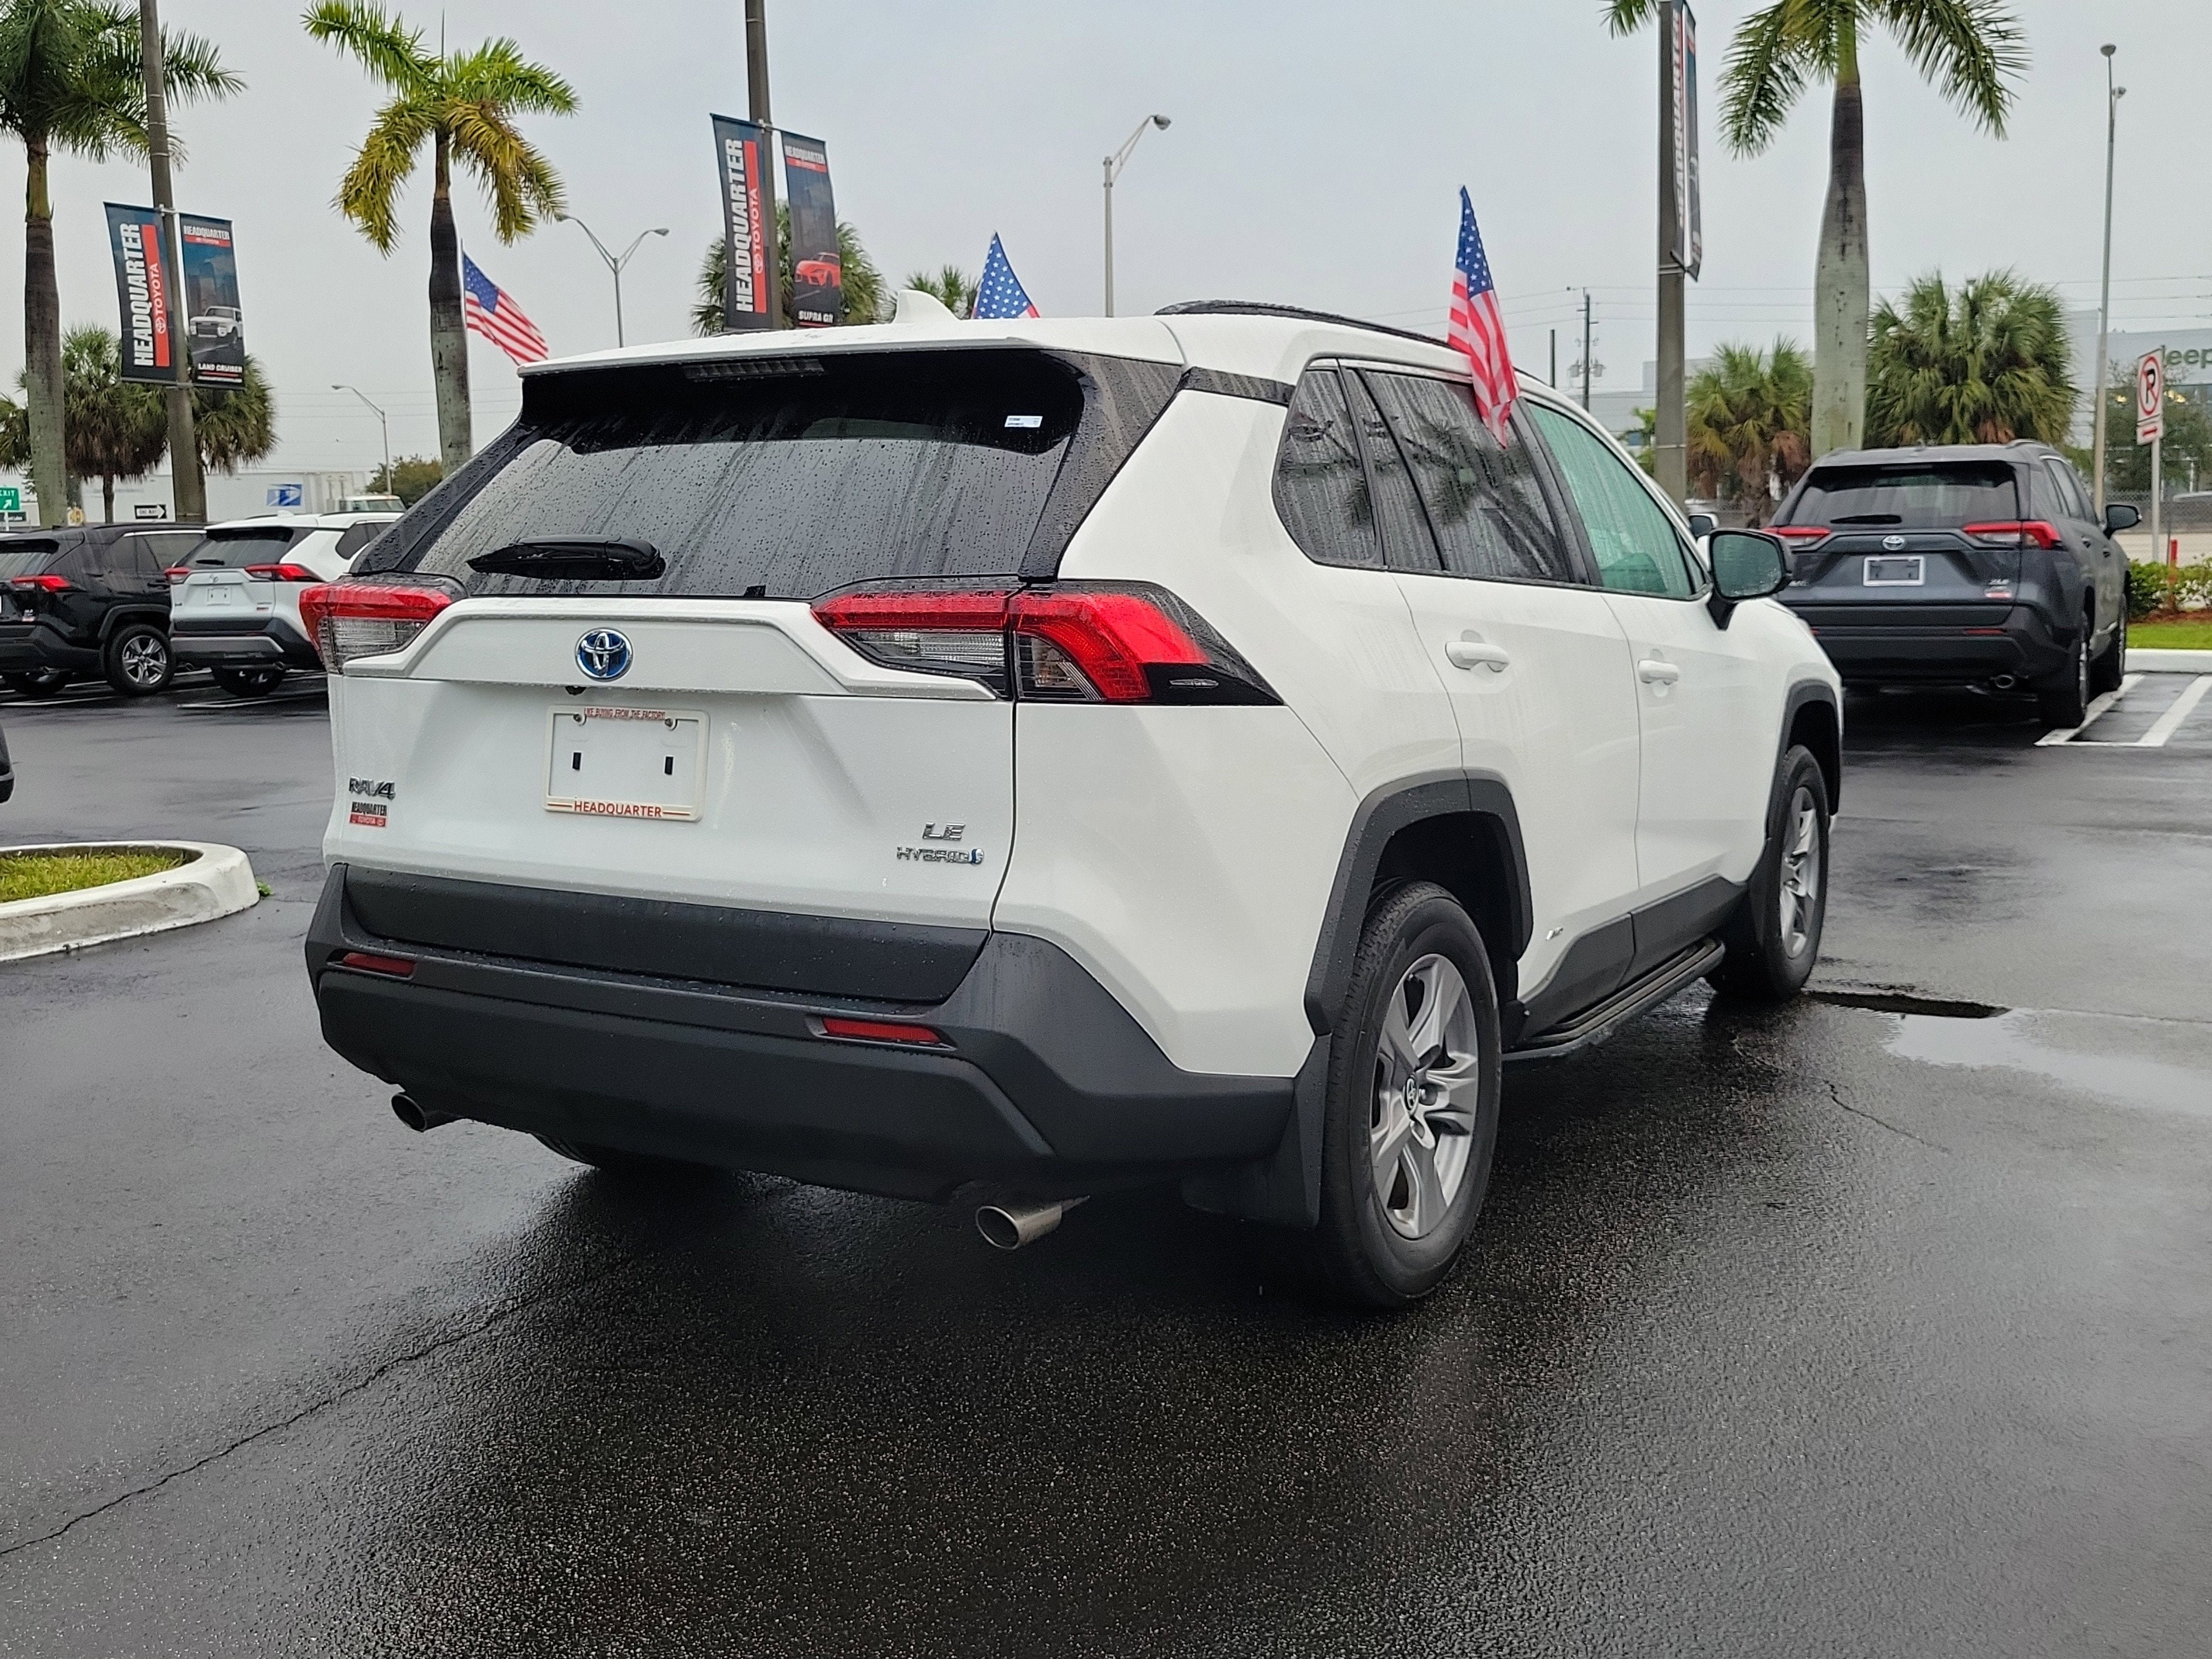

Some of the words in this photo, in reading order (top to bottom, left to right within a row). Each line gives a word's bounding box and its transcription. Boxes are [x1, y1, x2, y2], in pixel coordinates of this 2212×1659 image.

[725, 139, 753, 312] HEADQUARTER
[748, 188, 761, 251] TOYOTA
[120, 223, 154, 366] HEADQUARTER
[150, 263, 164, 316] TOYOTA
[798, 310, 822, 321] SUPRA
[198, 363, 215, 371] LAND
[2162, 346, 2212, 369] eep
[349, 776, 396, 801] RAV4
[574, 800, 662, 817] HEADQUARTER
[922, 821, 966, 841] LE
[896, 846, 970, 864] HYBRID
